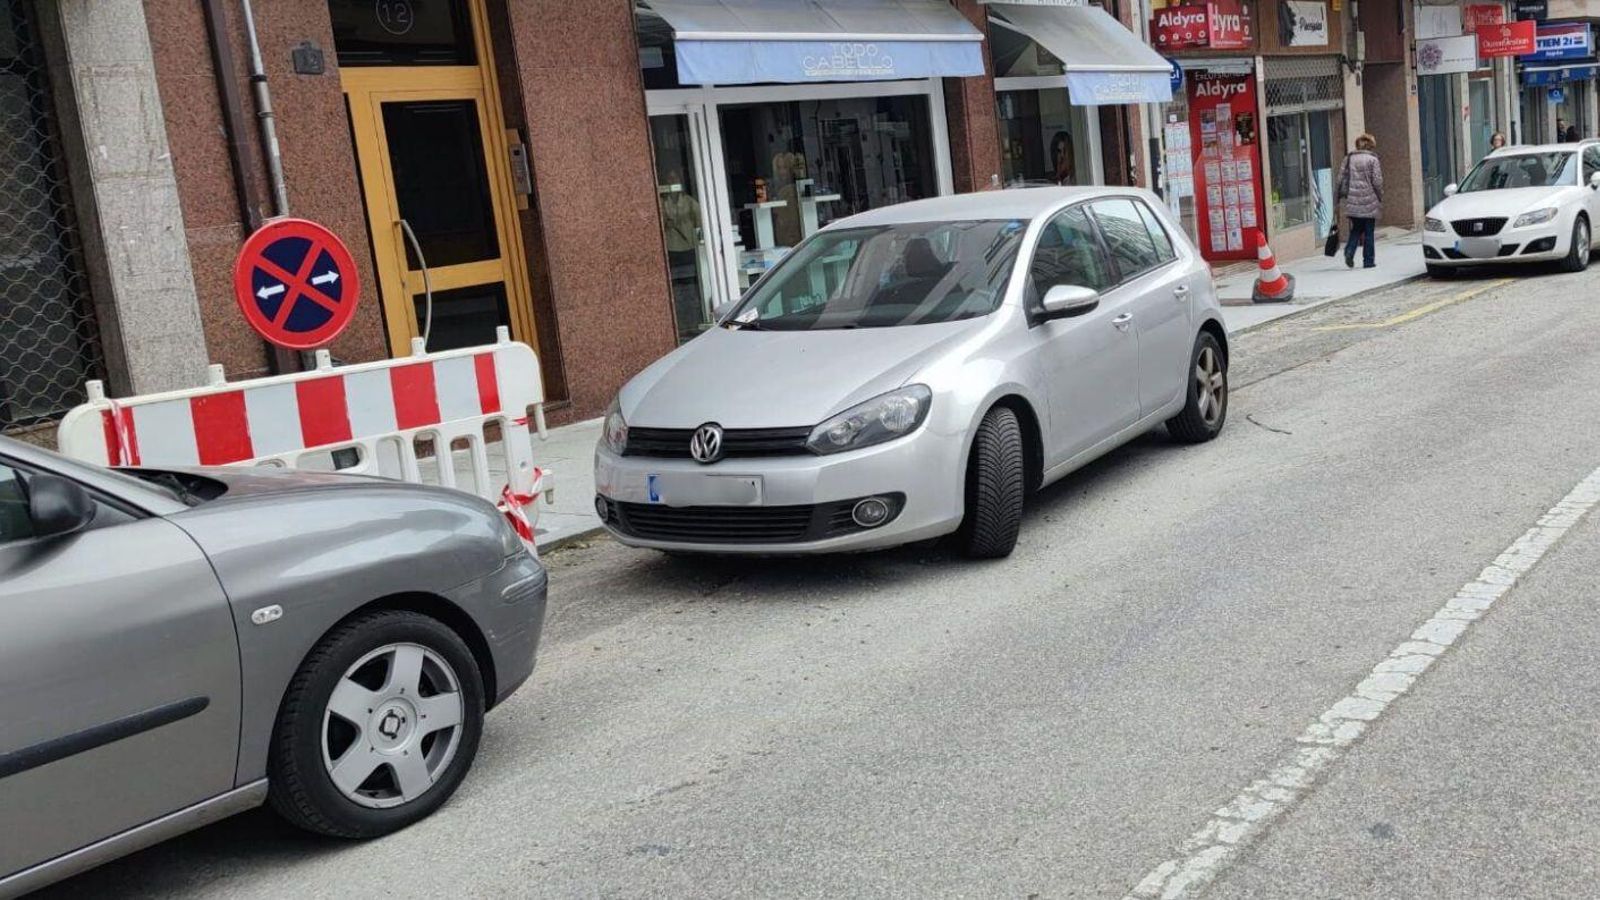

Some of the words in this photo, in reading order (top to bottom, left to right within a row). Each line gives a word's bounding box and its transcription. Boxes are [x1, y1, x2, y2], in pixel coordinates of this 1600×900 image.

[382, 2, 408, 23] 12
[1159, 11, 1205, 29] Aldyra
[1212, 4, 1240, 39] dyra
[831, 43, 878, 56] TODO
[802, 55, 894, 70] CABELLO
[1196, 79, 1247, 99] Aldyra
